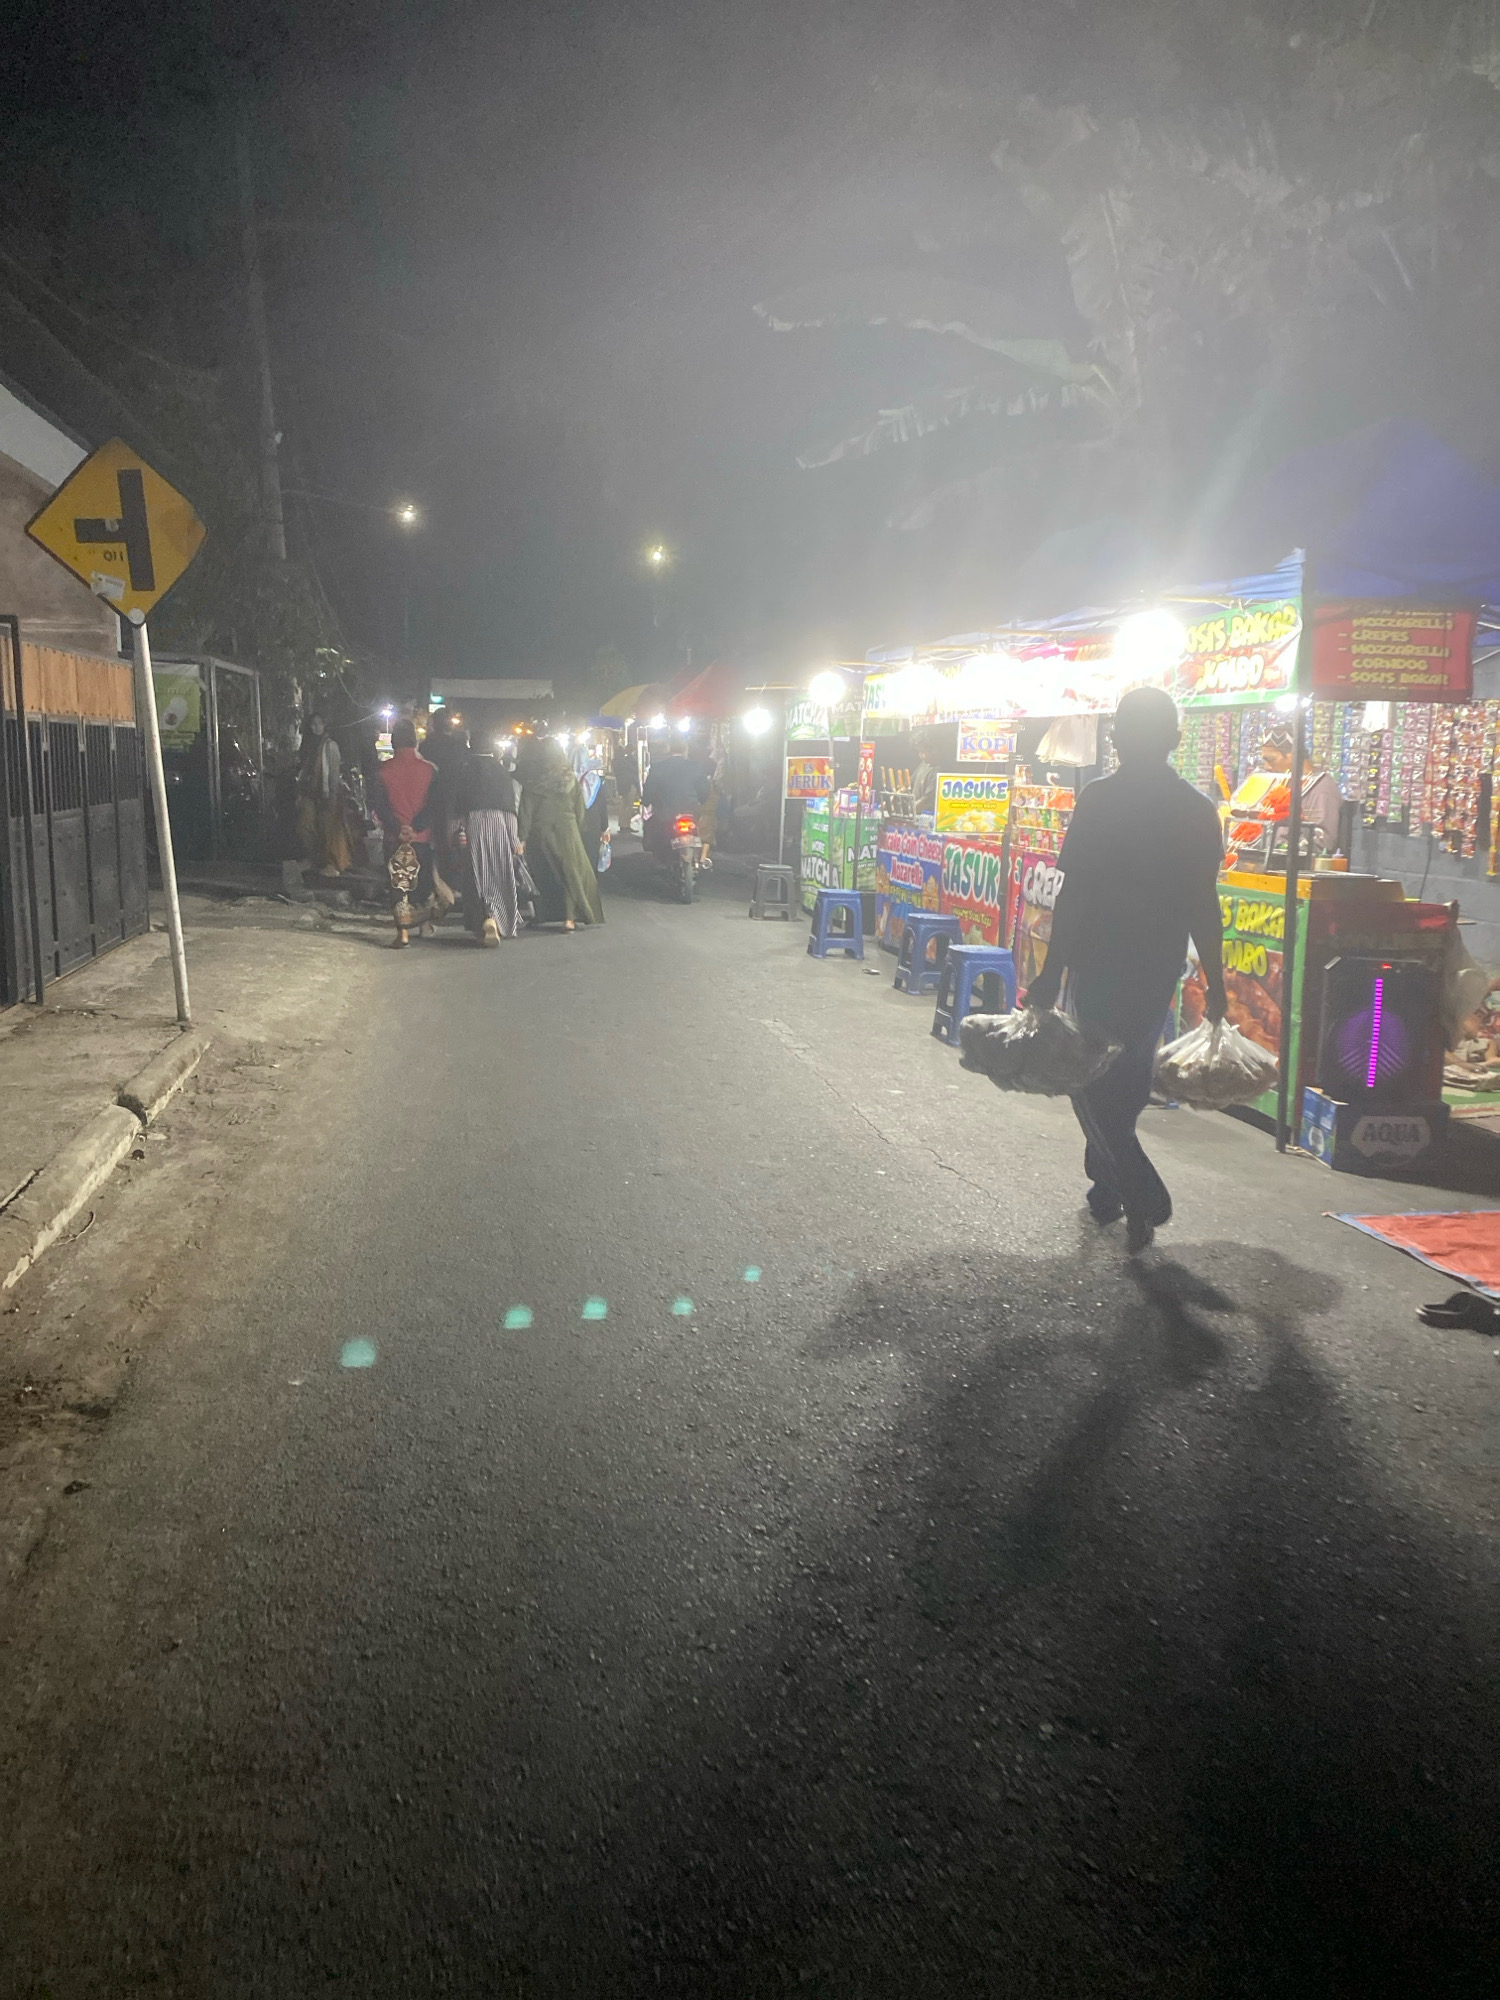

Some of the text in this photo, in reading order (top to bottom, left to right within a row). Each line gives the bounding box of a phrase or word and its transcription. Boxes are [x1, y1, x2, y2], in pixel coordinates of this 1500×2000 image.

[1184, 617, 1227, 653] OSIS
[1351, 629, 1410, 642] CREPES
[961, 736, 1014, 752] KOPI
[788, 775, 832, 789] JERUK
[941, 780, 1008, 800] JASUKE
[942, 843, 1000, 910] JASUK
[1024, 860, 1066, 911] CREP
[1235, 899, 1285, 939] BAKA
[1222, 940, 1268, 976] MBO
[1361, 1122, 1420, 1146] AQUA
